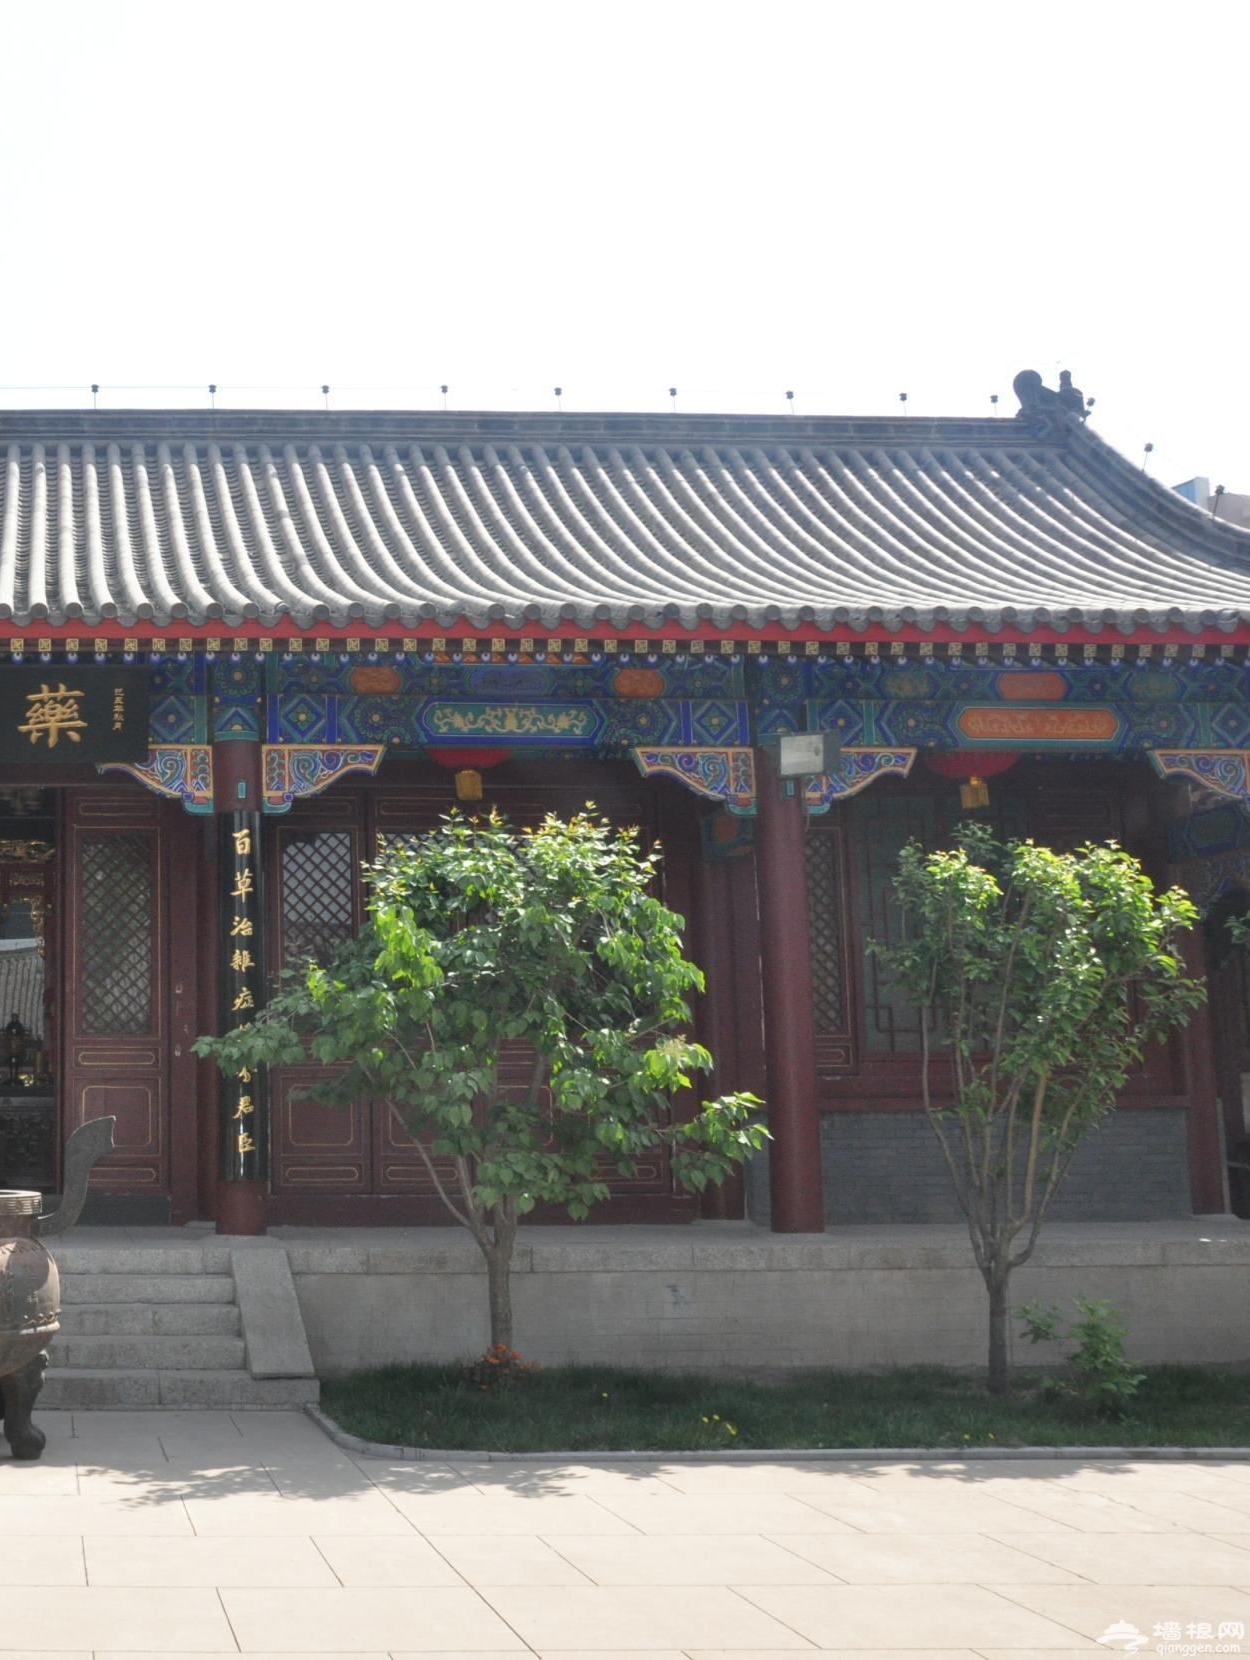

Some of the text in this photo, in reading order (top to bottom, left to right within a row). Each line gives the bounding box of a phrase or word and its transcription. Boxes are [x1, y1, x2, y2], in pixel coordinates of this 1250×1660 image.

[230, 828, 255, 1153] 百草治雜症分君臣
